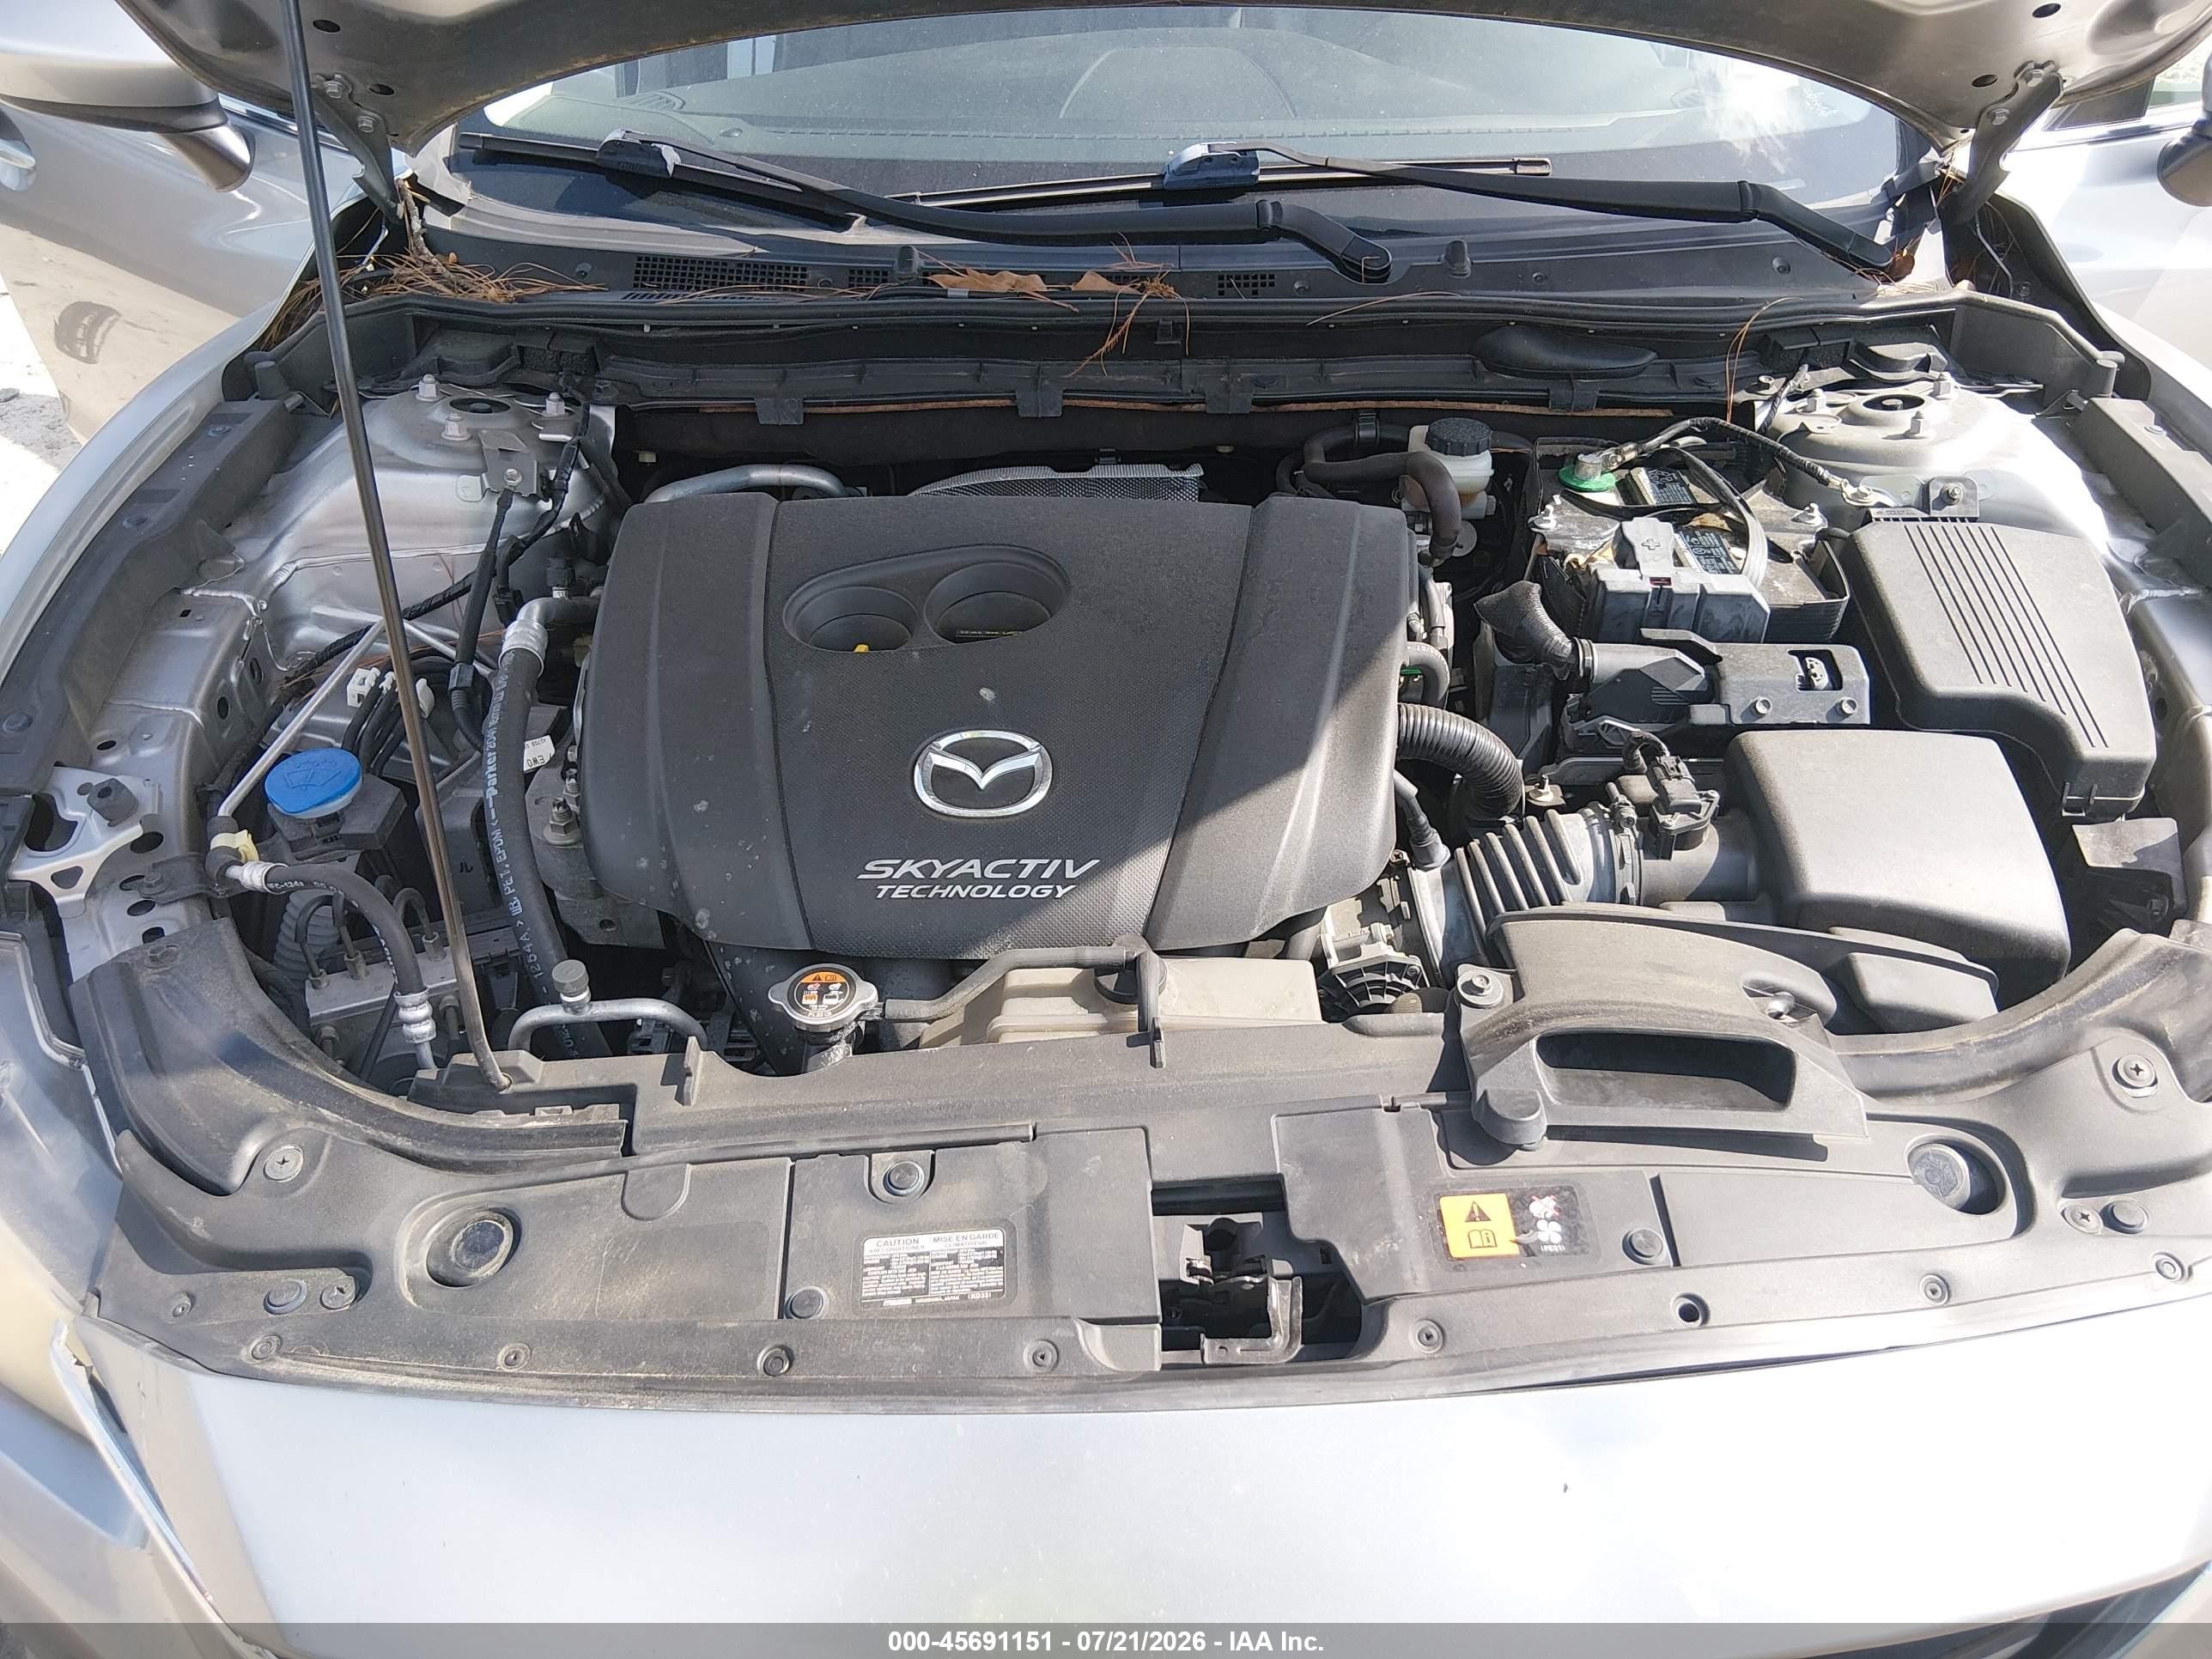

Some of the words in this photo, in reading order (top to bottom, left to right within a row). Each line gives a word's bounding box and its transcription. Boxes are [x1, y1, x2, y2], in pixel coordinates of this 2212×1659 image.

[857, 860, 1100, 878] SKYACTIV
[876, 884, 1078, 899] TECHNOLOGY
[877, 1237, 919, 1247] CAUTION
[969, 1232, 1001, 1241] GARDE
